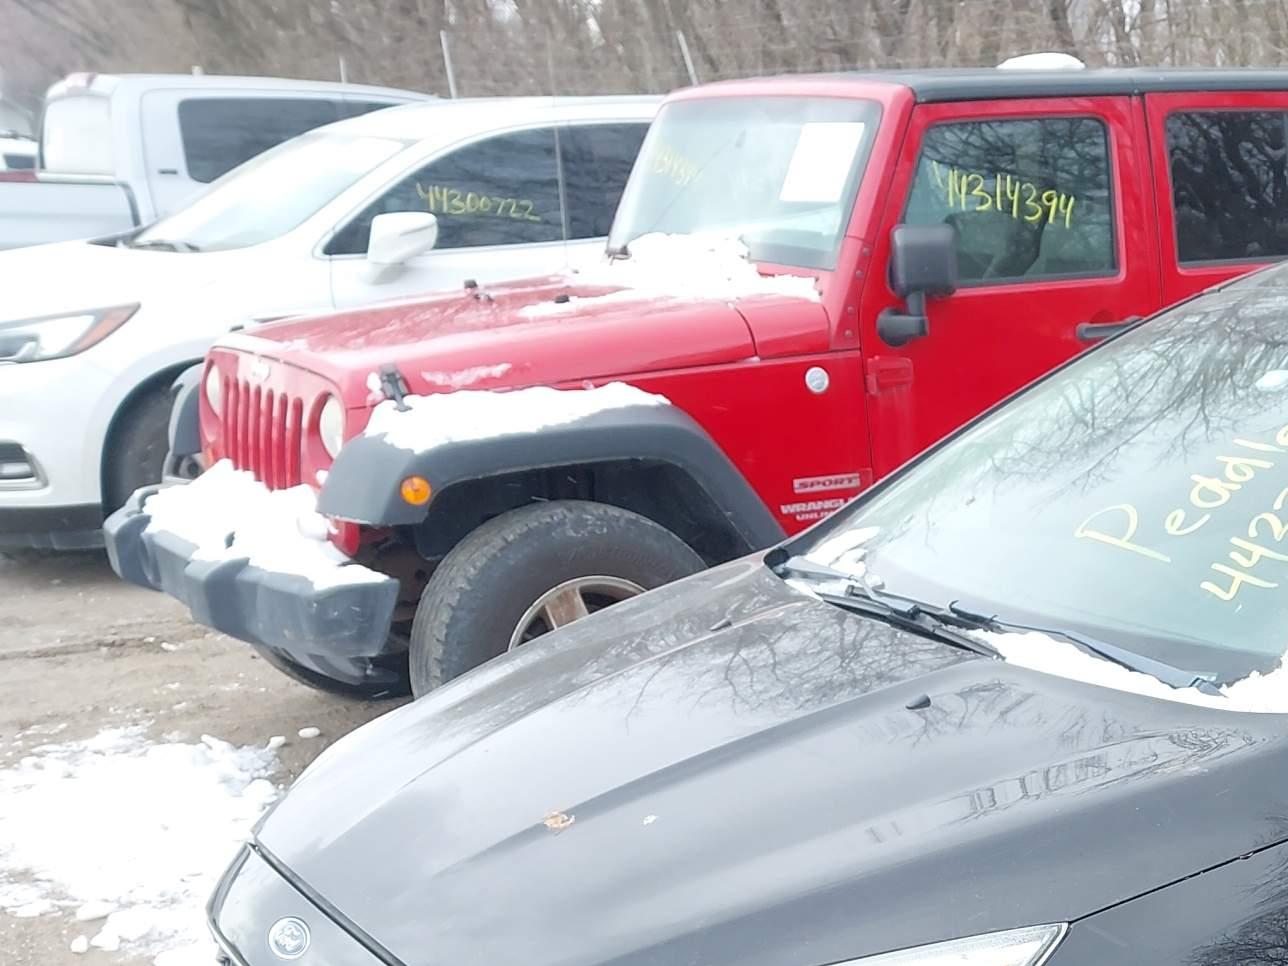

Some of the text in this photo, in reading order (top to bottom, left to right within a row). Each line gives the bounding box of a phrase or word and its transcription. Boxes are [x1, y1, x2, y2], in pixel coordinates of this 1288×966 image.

[416, 182, 541, 221] 44300722
[932, 160, 1075, 229] 44314394
[798, 476, 857, 489] SPORT
[780, 497, 853, 514] WRANGL
